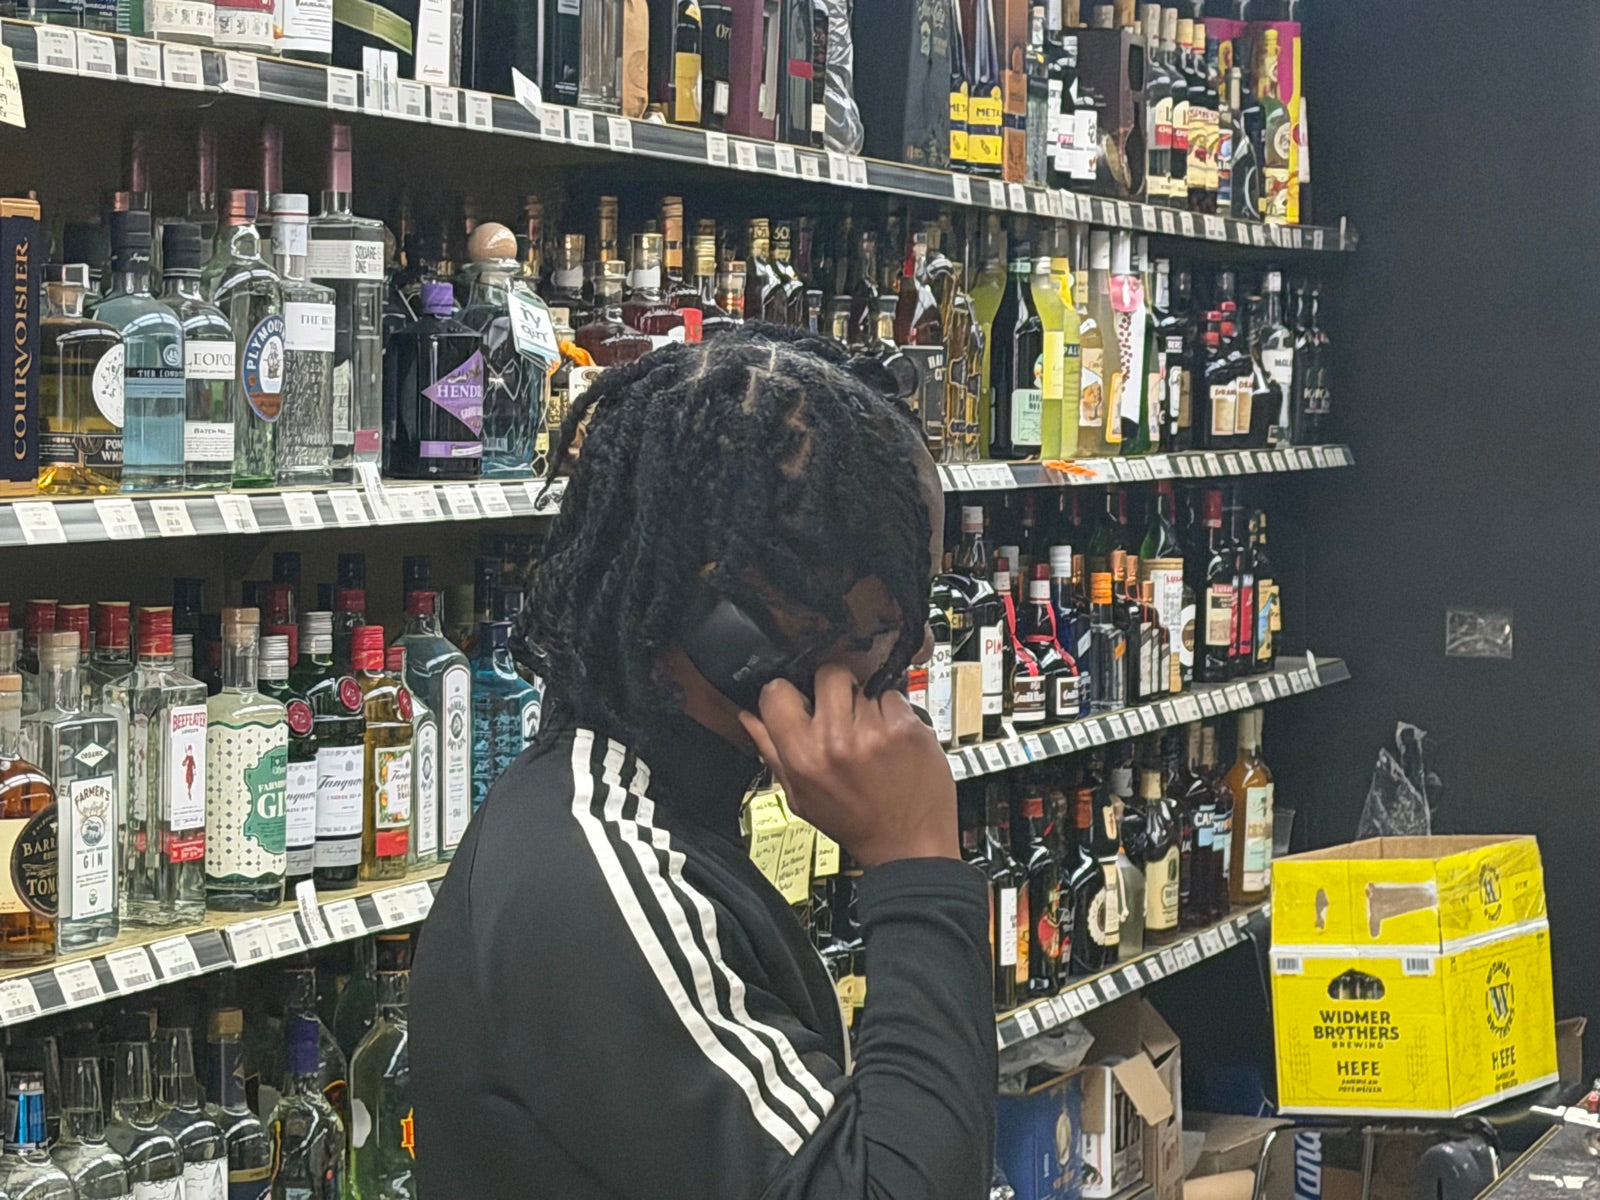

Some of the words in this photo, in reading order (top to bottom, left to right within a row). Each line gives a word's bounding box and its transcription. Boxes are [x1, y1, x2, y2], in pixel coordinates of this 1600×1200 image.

[355, 260, 366, 273] ONE
[15, 241, 32, 460] COURVOISIER
[172, 712, 206, 731] BEEFEATER
[257, 792, 286, 818] GI
[83, 852, 103, 868] GIN
[1319, 1010, 1391, 1025] WIDMER
[1313, 1026, 1400, 1040] BROTHERS
[1332, 1041, 1384, 1049] BREWING
[1492, 1046, 1516, 1071] HEFE
[1337, 1061, 1381, 1076] HEFE
